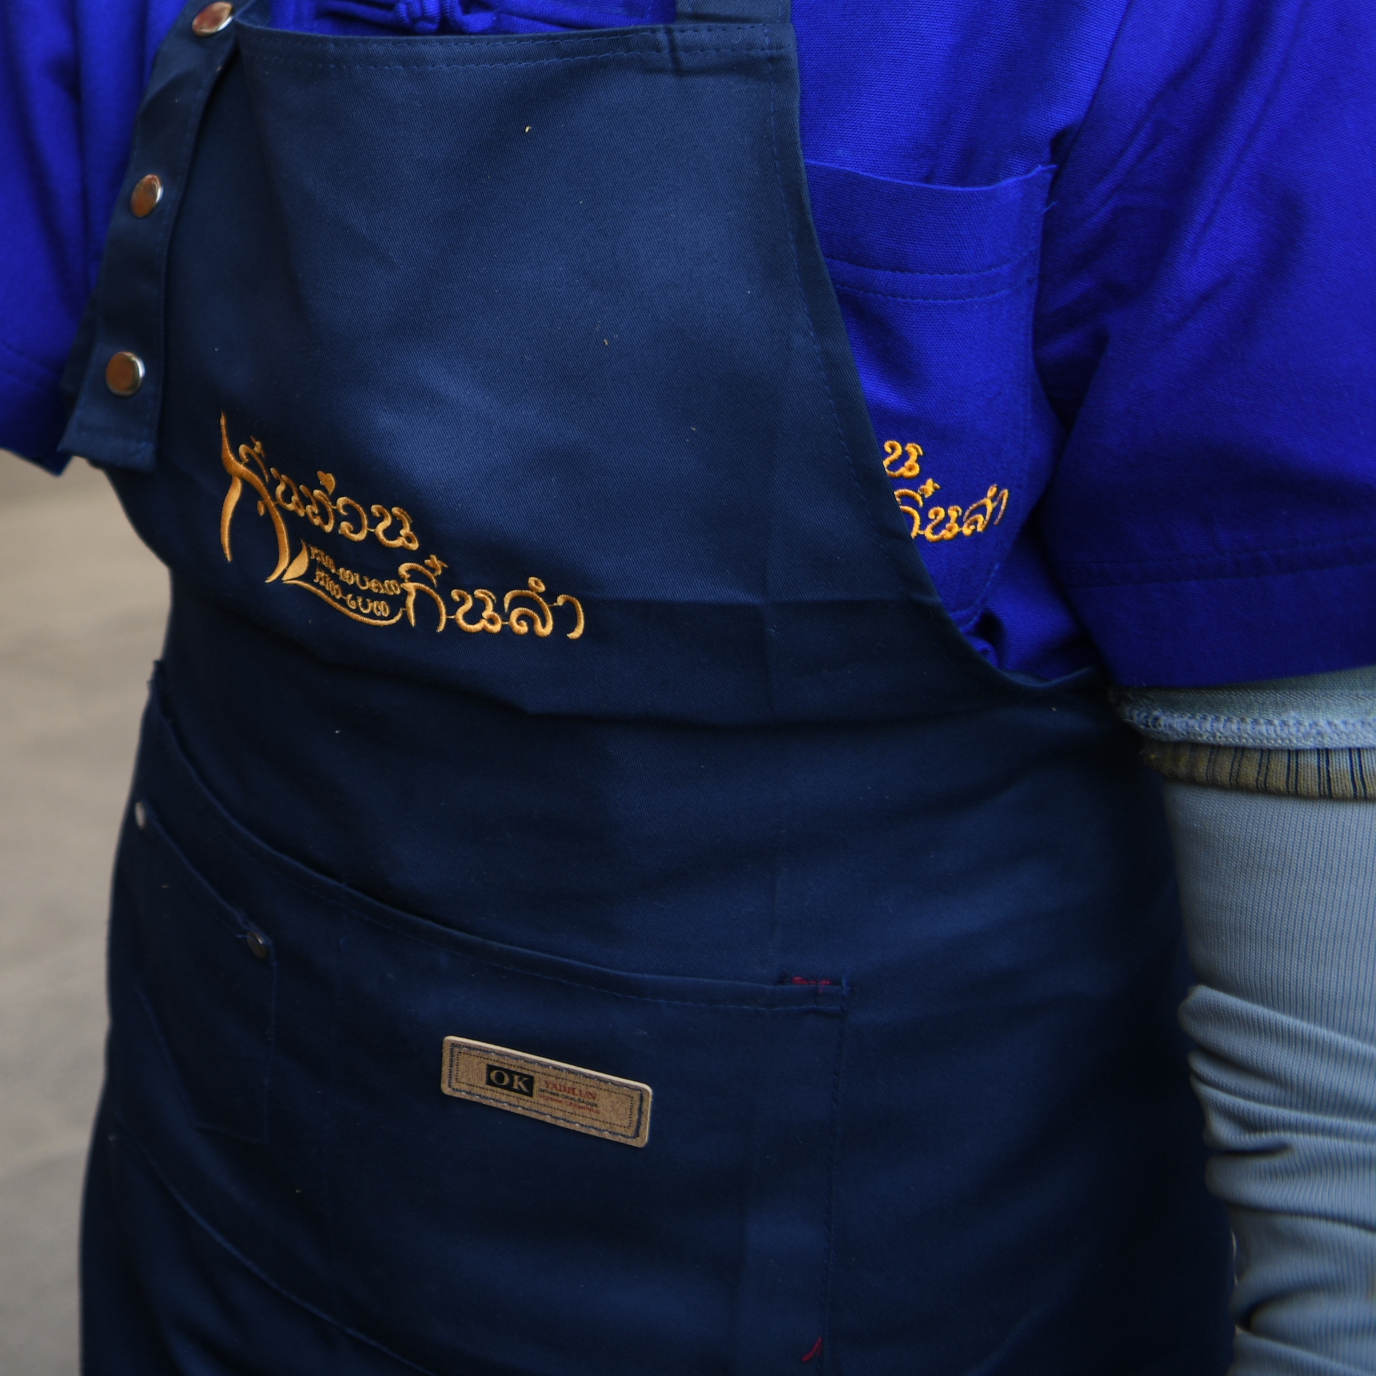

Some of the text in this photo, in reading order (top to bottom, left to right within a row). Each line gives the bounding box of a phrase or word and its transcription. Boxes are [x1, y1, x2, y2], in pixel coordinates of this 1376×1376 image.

[397, 554, 585, 641] กิ๋นลำ
[490, 1069, 529, 1093] OK
